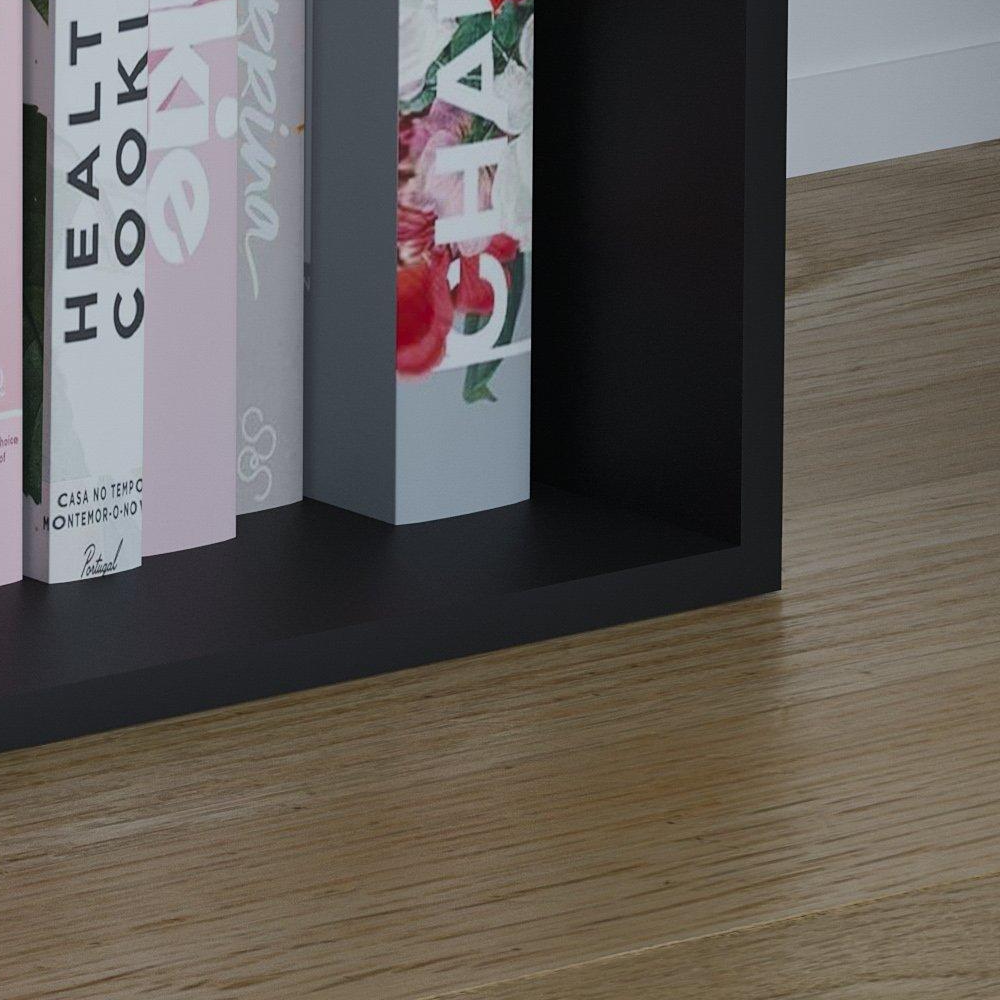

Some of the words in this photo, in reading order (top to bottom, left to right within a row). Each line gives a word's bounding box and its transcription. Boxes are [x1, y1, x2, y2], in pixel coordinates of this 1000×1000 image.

[57, 488, 89, 508] CASA
[93, 485, 107, 502] NO
[80, 537, 124, 579] Portugal
